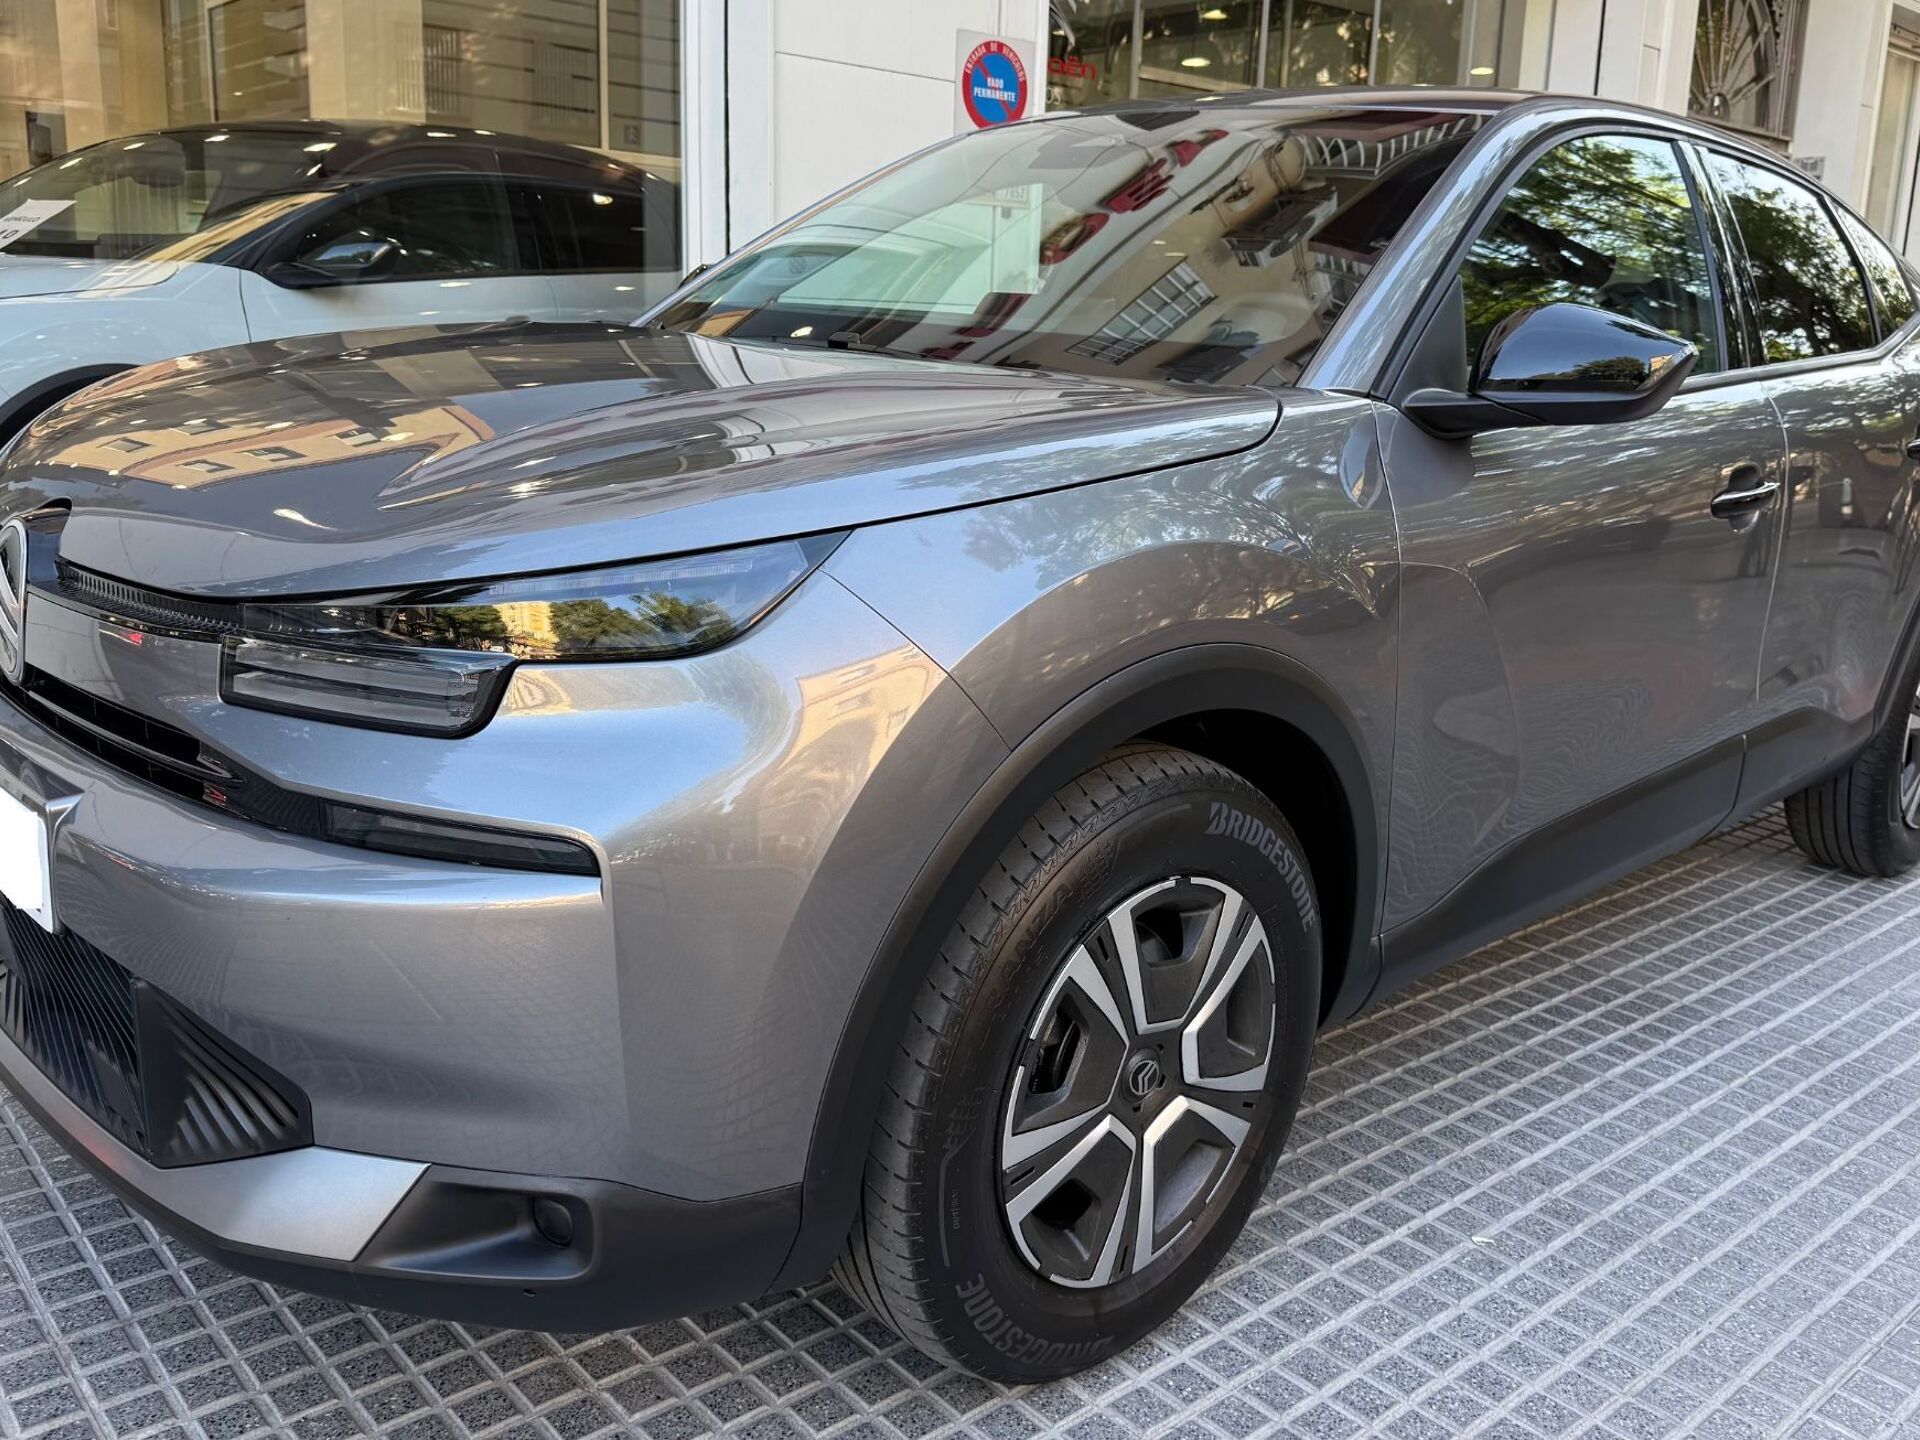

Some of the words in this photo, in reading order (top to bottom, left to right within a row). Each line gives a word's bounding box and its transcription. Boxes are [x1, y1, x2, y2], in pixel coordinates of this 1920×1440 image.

[989, 42, 998, 52] DE
[987, 77, 1004, 89] VADO
[973, 86, 1016, 103] PERMANENTE
[1205, 802, 1317, 933] BRIDGESTONE
[956, 1273, 1114, 1365] BRIDGESTONE
